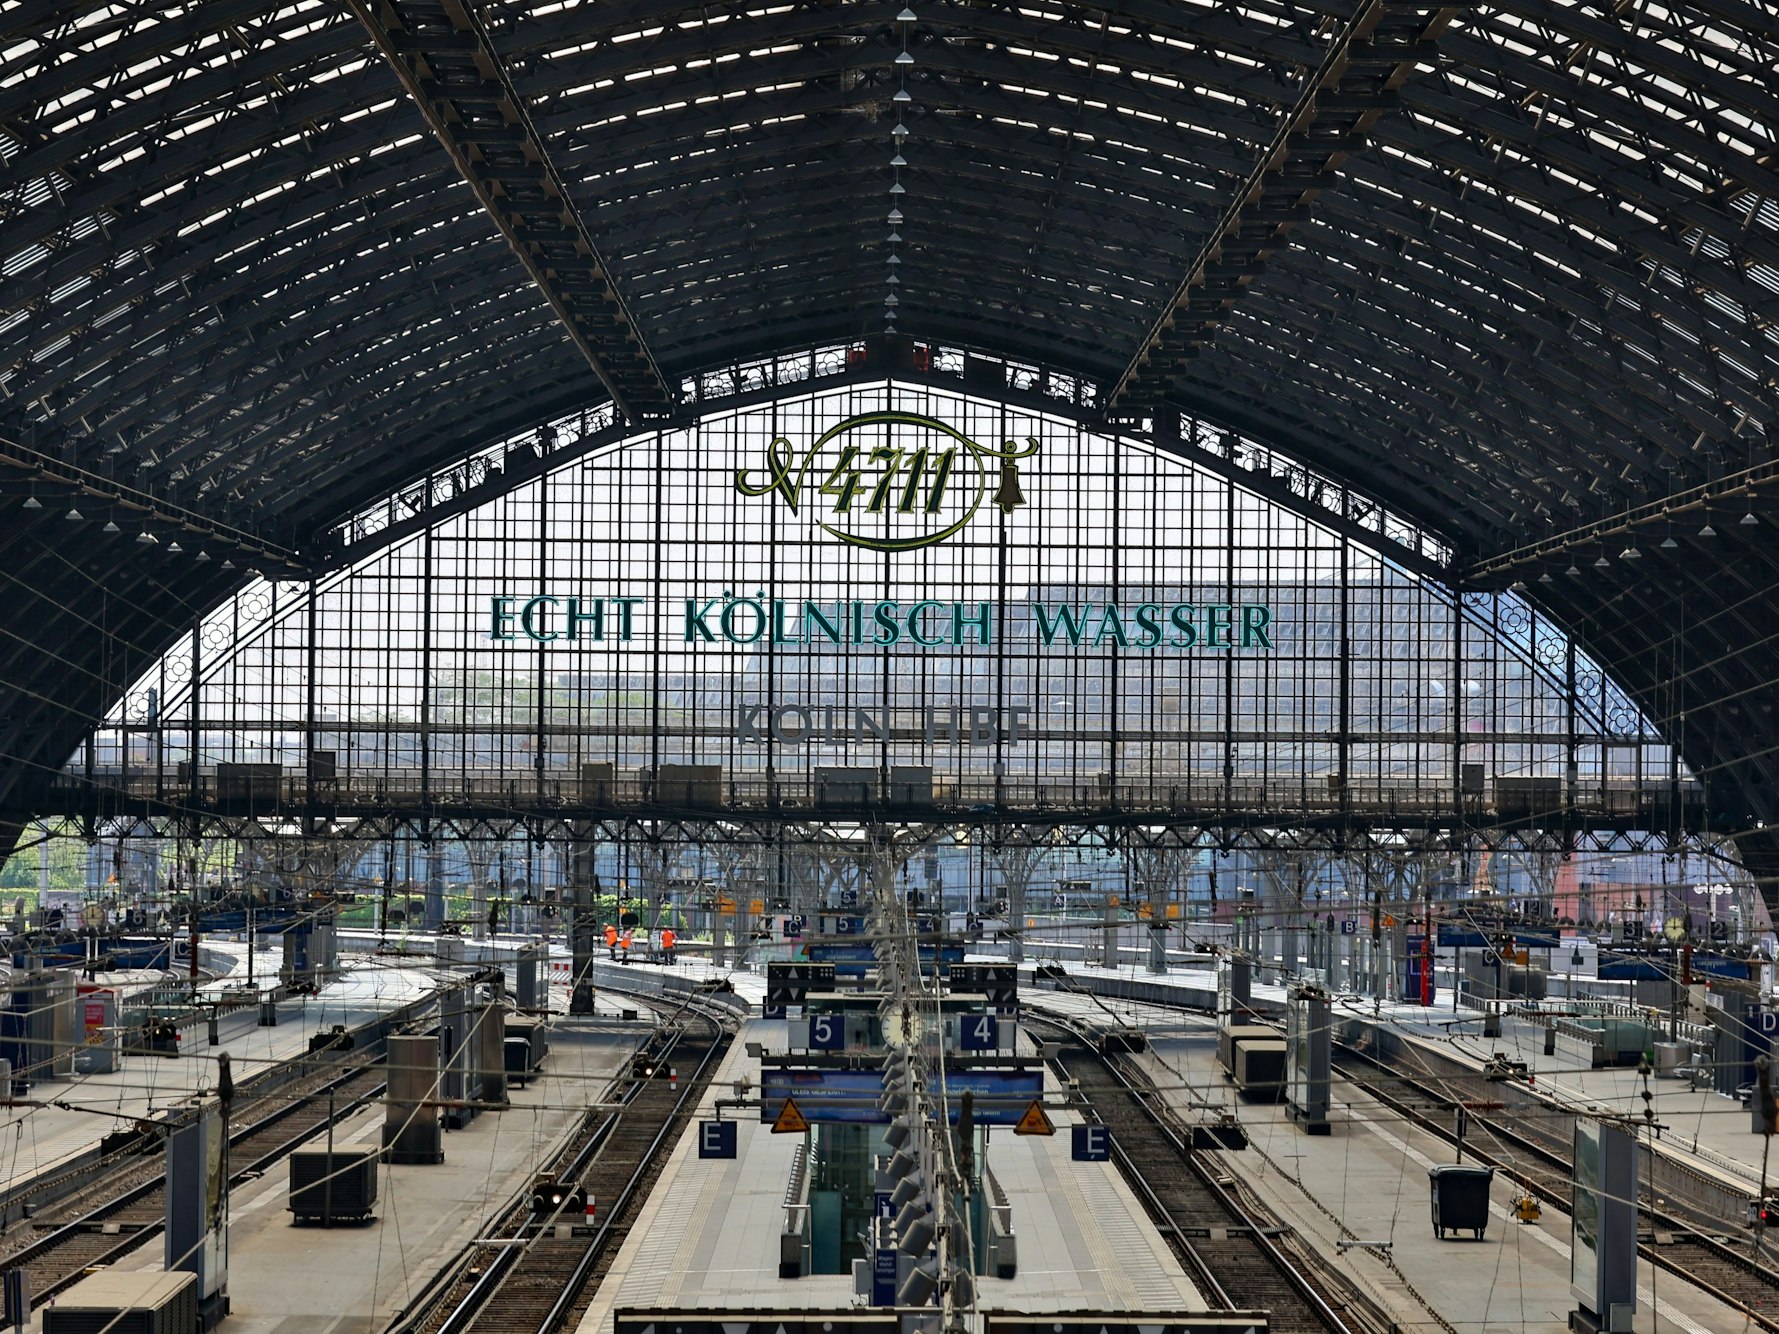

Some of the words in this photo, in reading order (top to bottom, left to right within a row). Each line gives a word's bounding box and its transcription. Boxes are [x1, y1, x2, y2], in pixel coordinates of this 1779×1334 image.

[819, 446, 957, 514] 4711
[489, 596, 644, 642] ECHT
[684, 589, 992, 647] KÖLNISCH
[1033, 602, 1274, 649] WASSER
[737, 703, 890, 746] KÖLN
[925, 704, 1032, 747] HBF
[839, 916, 849, 931] 5
[1345, 922, 1354, 933] B
[1626, 922, 1636, 936] 3
[1714, 922, 1723, 937] 2
[815, 1016, 832, 1042] 5
[973, 1016, 991, 1043] 4
[1762, 1013, 1777, 1032] D
[704, 1122, 721, 1151] E
[1087, 1127, 1105, 1153] E
